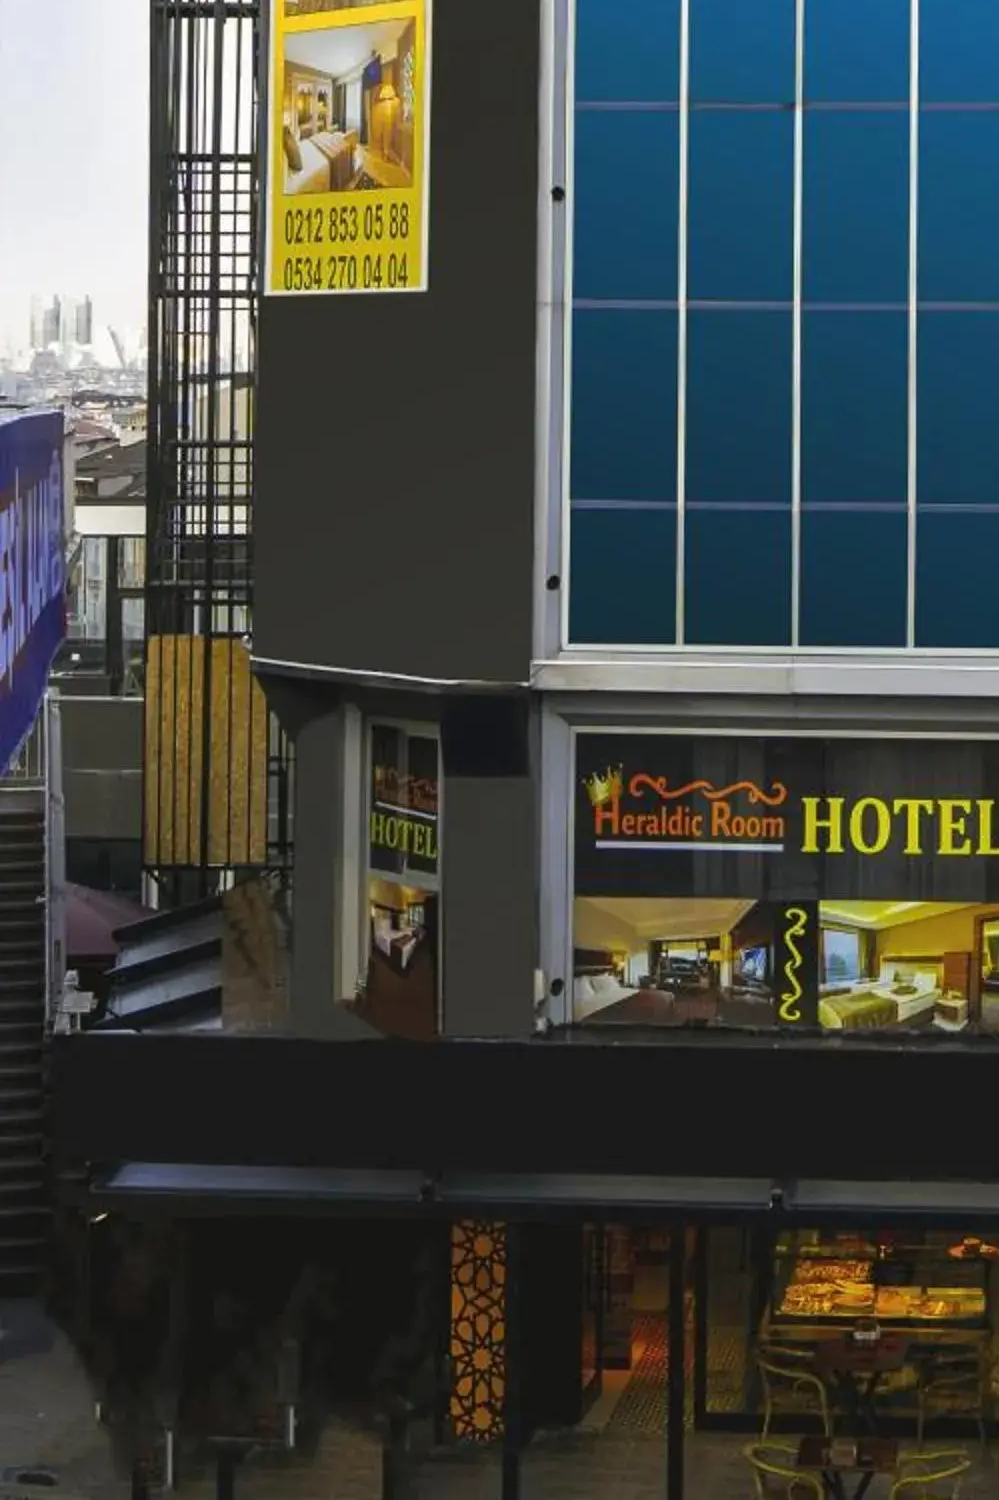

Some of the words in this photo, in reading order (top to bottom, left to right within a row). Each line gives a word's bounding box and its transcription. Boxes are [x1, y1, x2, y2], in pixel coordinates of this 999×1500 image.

[284, 206, 323, 245] 0212
[329, 205, 359, 243] 853
[363, 203, 384, 241] 05
[389, 202, 409, 240] 88
[284, 256, 323, 291] 0534
[327, 255, 358, 290] 270
[363, 253, 383, 289] 04
[388, 252, 409, 289] 04
[595, 785, 704, 837] Heraldic
[711, 800, 785, 838] Room
[370, 811, 437, 859] HOTEL
